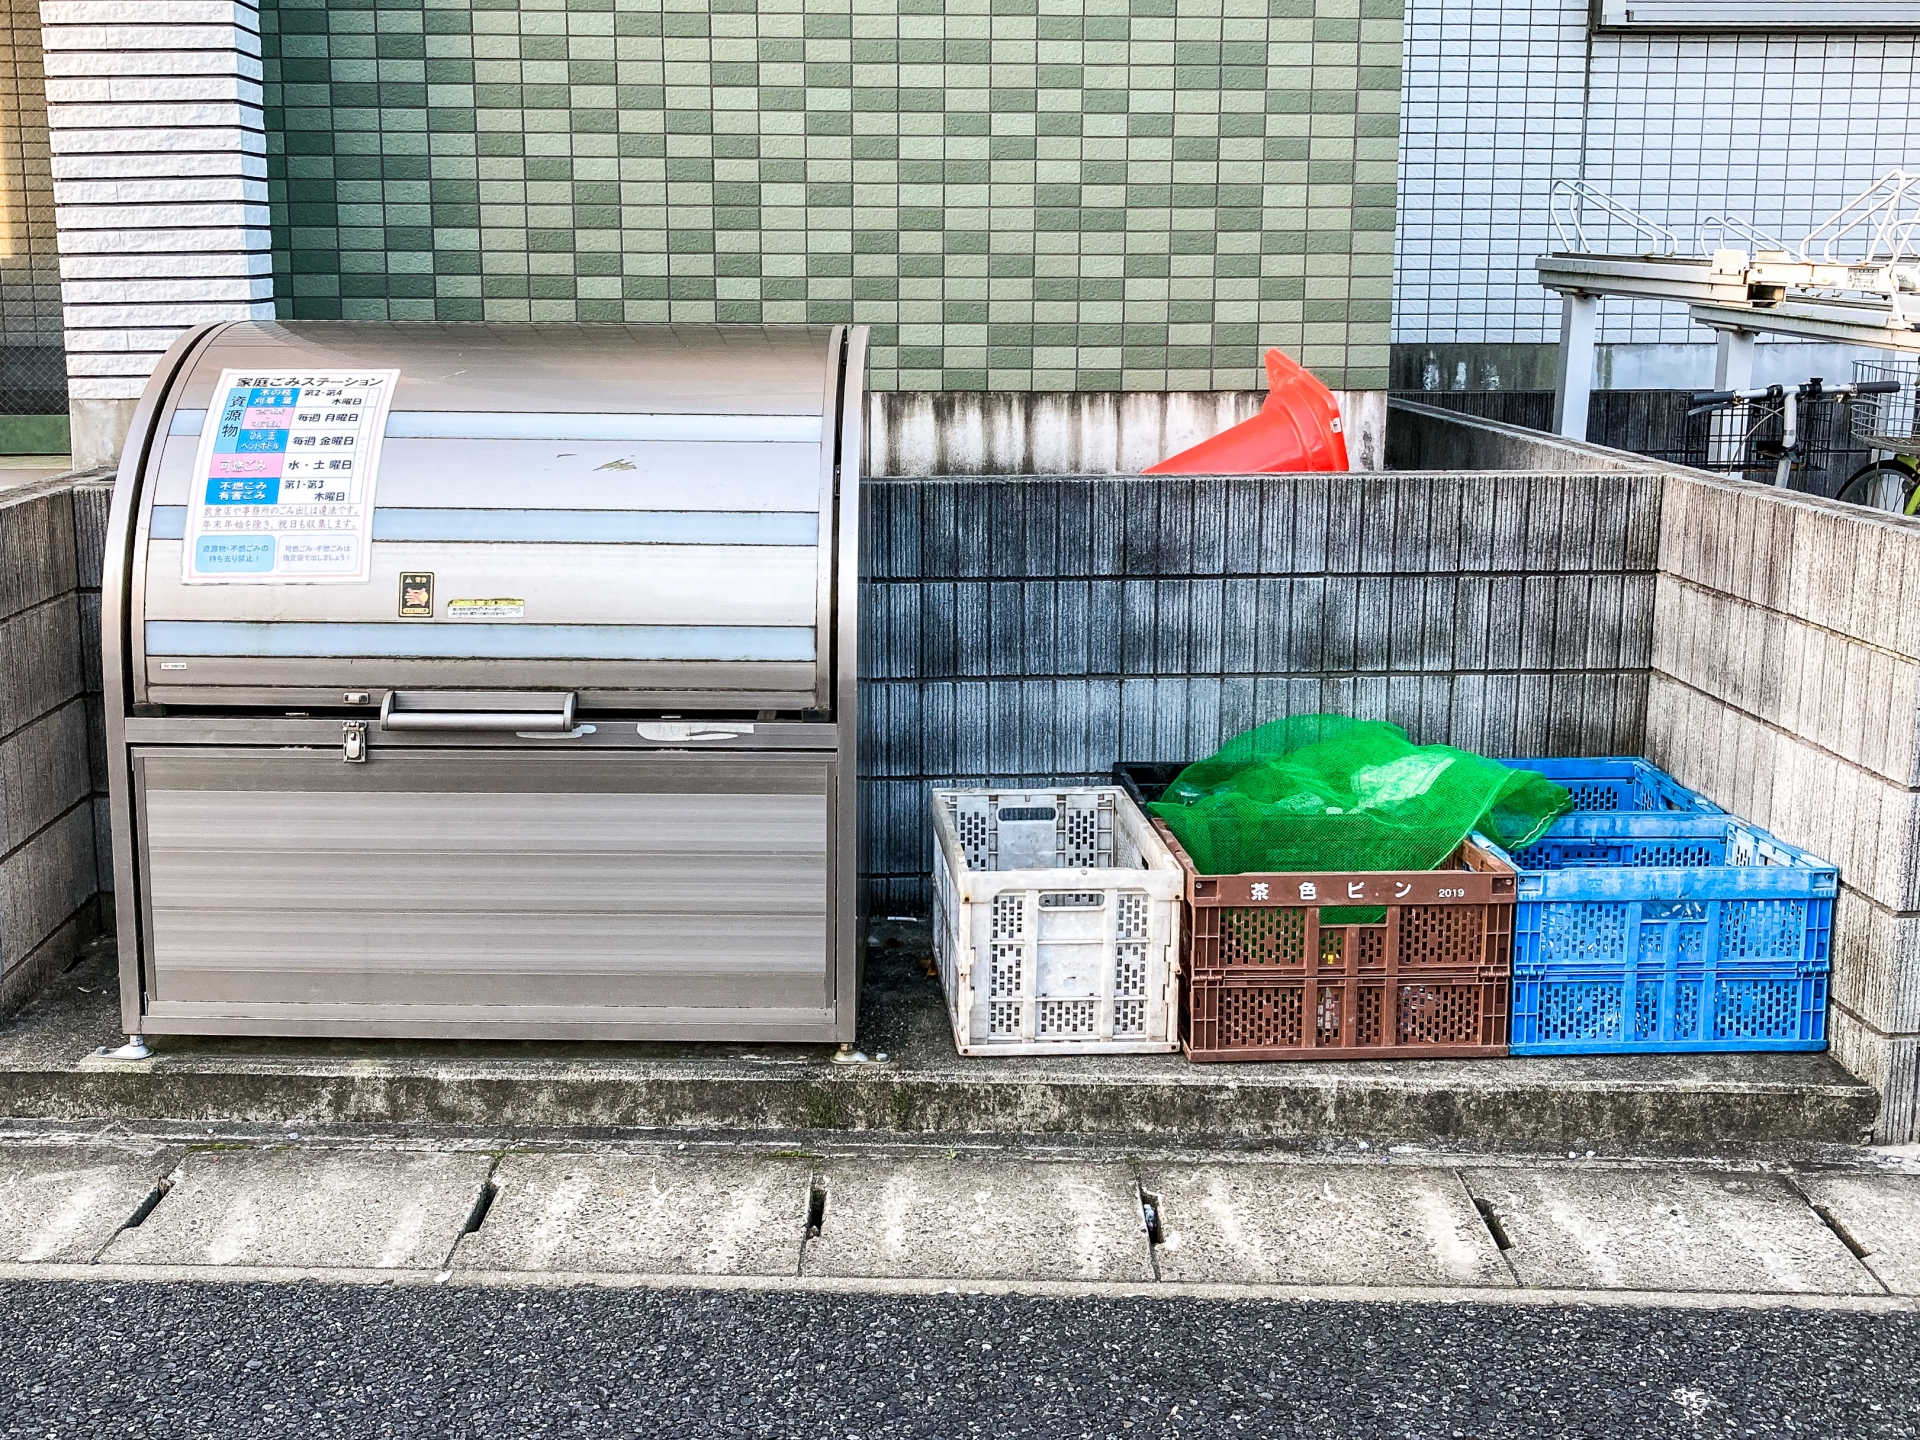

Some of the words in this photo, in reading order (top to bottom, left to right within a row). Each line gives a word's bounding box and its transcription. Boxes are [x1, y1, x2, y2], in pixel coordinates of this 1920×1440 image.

[236, 377, 384, 388] 家庭ごみステーション
[331, 398, 362, 406] 木曜日
[221, 395, 247, 438] 資源物
[324, 413, 359, 422] 月曜日
[319, 436, 354, 446] 金曜日
[220, 459, 267, 473] 可燃ごみ
[219, 481, 268, 491] 不燃ごみ
[314, 492, 346, 502] 木曜日
[1438, 888, 1465, 898] 2019
